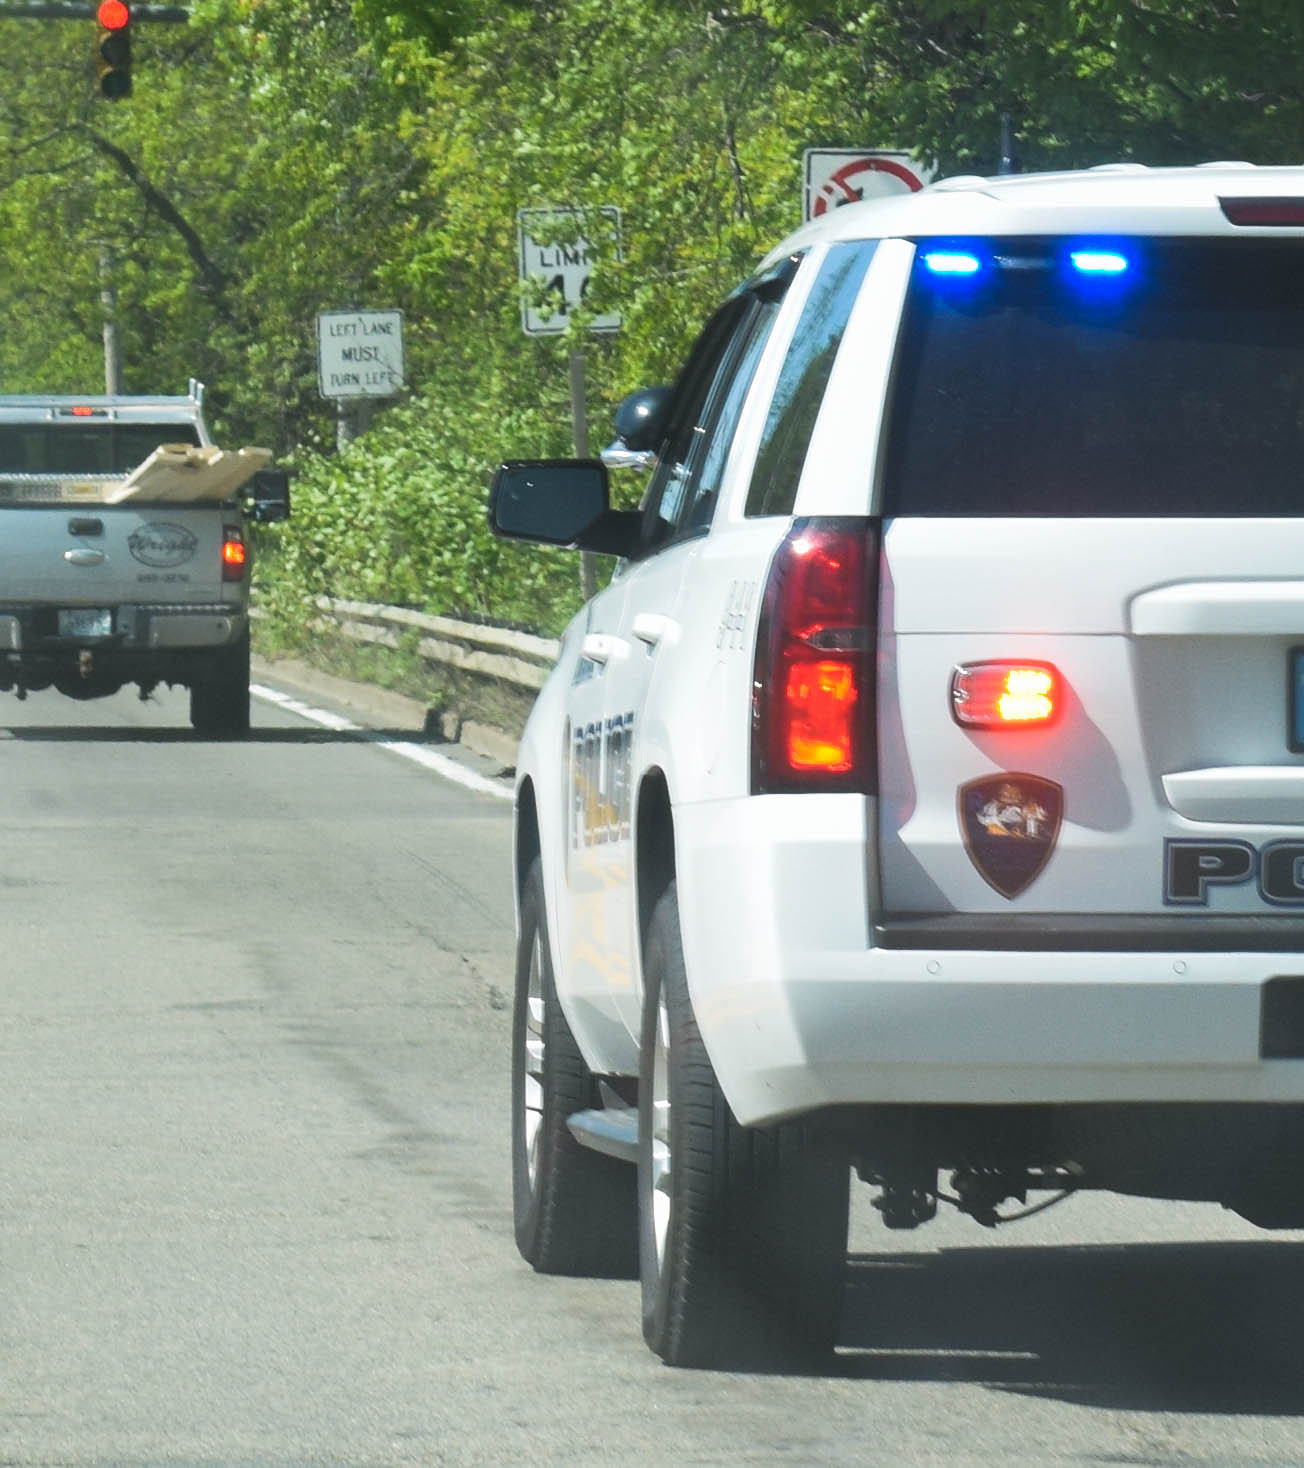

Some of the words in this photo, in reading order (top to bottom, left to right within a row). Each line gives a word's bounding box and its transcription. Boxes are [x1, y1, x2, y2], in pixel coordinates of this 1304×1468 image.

[330, 324, 357, 337] LEFT
[363, 322, 394, 336] LANE
[342, 347, 379, 362] MUST
[330, 373, 360, 387] TURN
